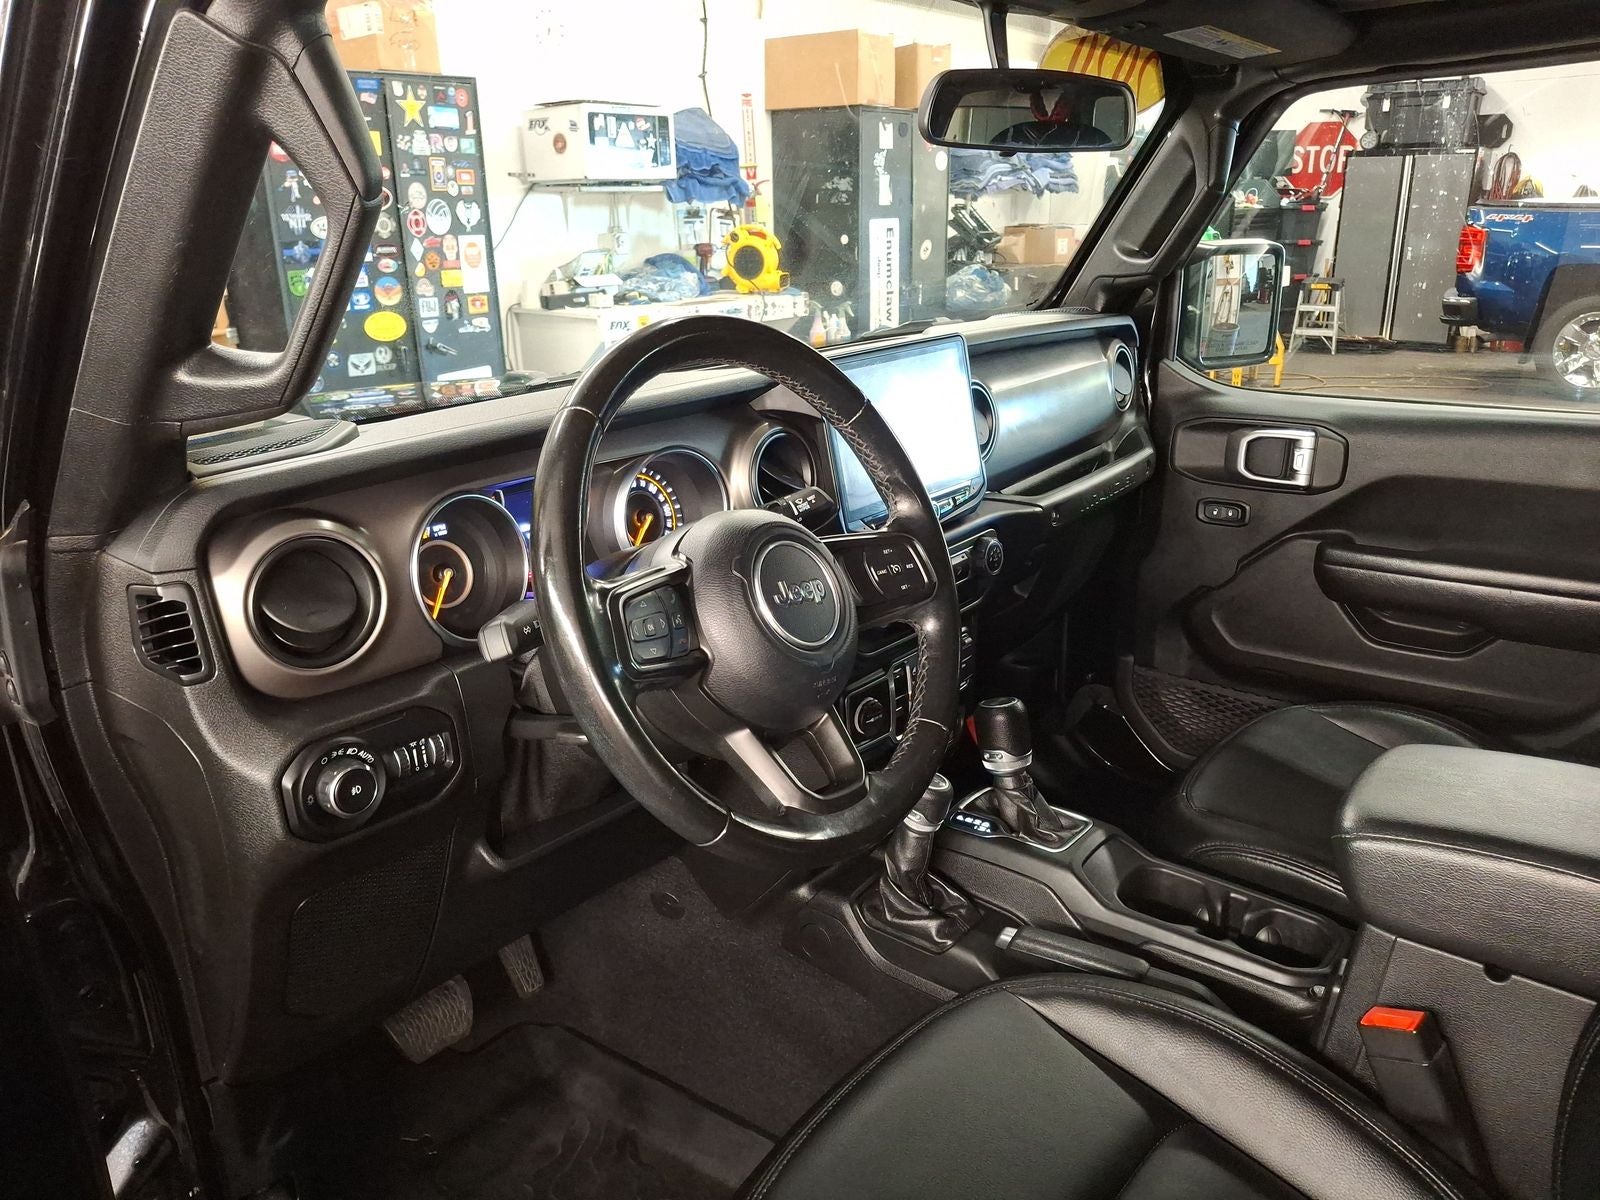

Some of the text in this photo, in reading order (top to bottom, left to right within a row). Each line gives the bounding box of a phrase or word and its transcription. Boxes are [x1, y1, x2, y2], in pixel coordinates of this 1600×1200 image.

[886, 227, 894, 322] Enumclaw
[773, 579, 826, 606] Jeep
[357, 750, 374, 763] AUTO
